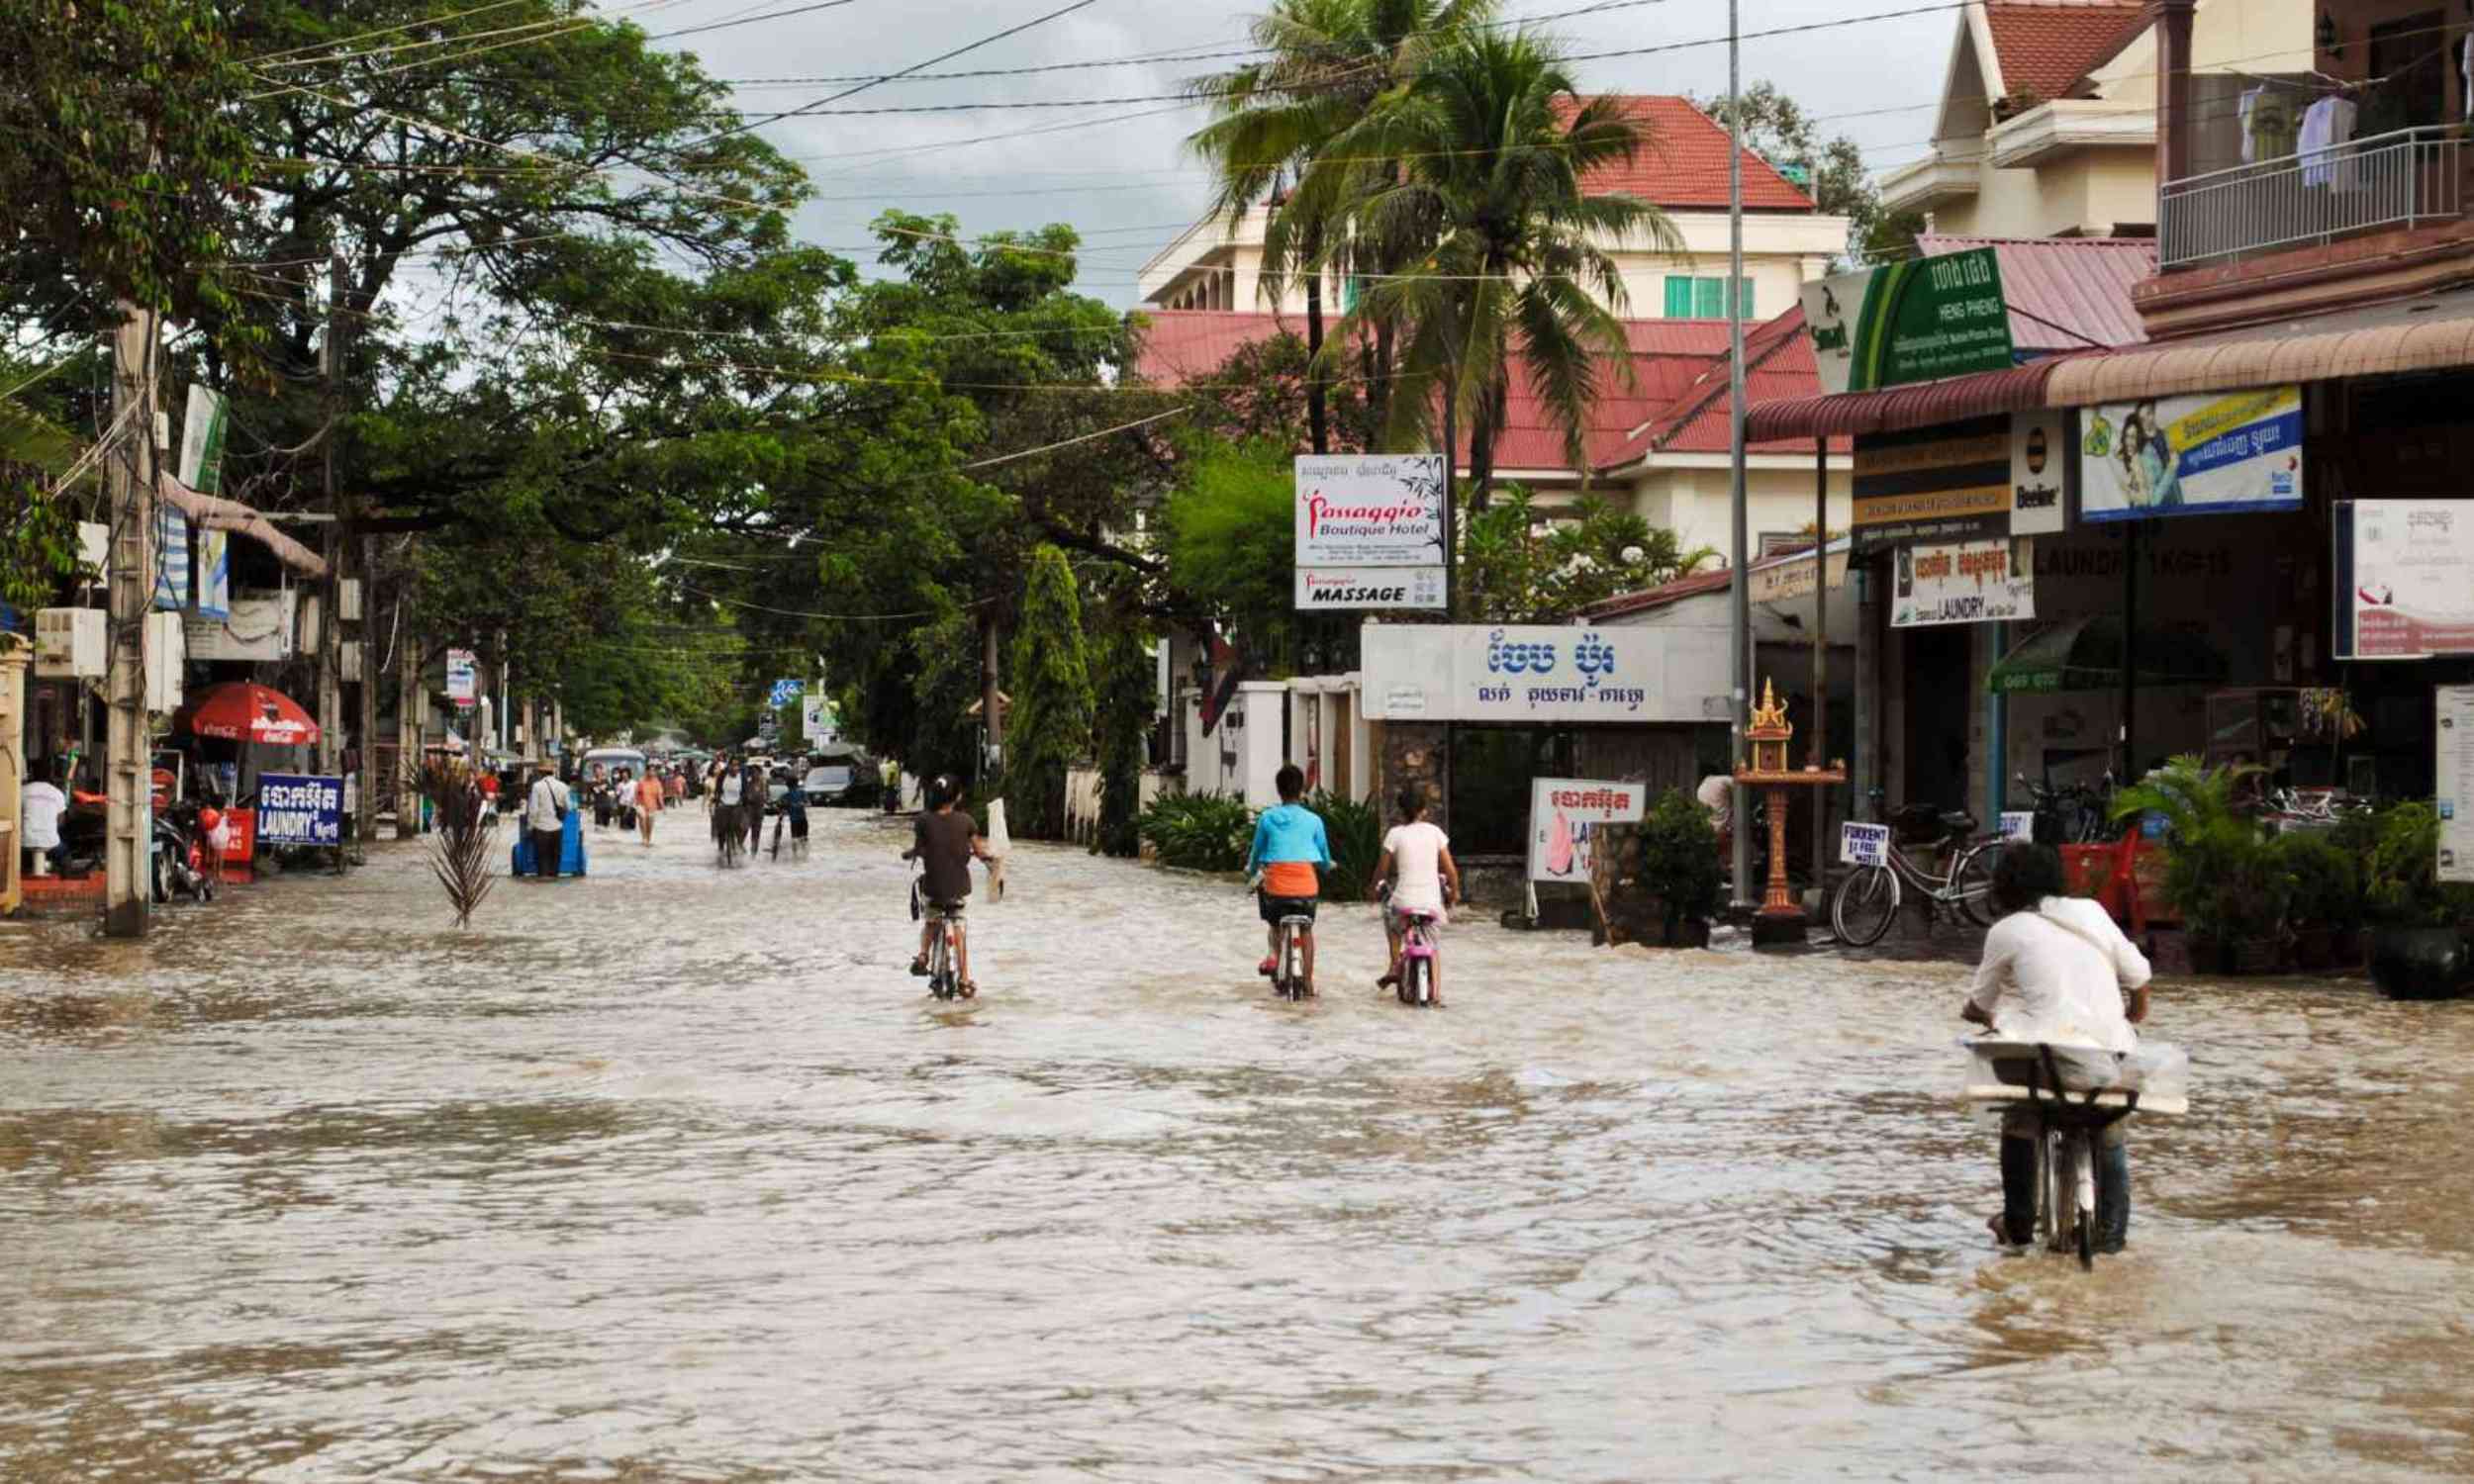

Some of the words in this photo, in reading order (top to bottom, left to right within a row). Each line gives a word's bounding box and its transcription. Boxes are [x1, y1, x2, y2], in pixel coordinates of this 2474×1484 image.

[1320, 523, 1385, 537] Boutique
[1388, 523, 1429, 536] Hotel
[1312, 587, 1405, 603] MASSAGE
[1939, 597, 1985, 621] LAUNDRY
[258, 809, 312, 837] LAUNDRY
